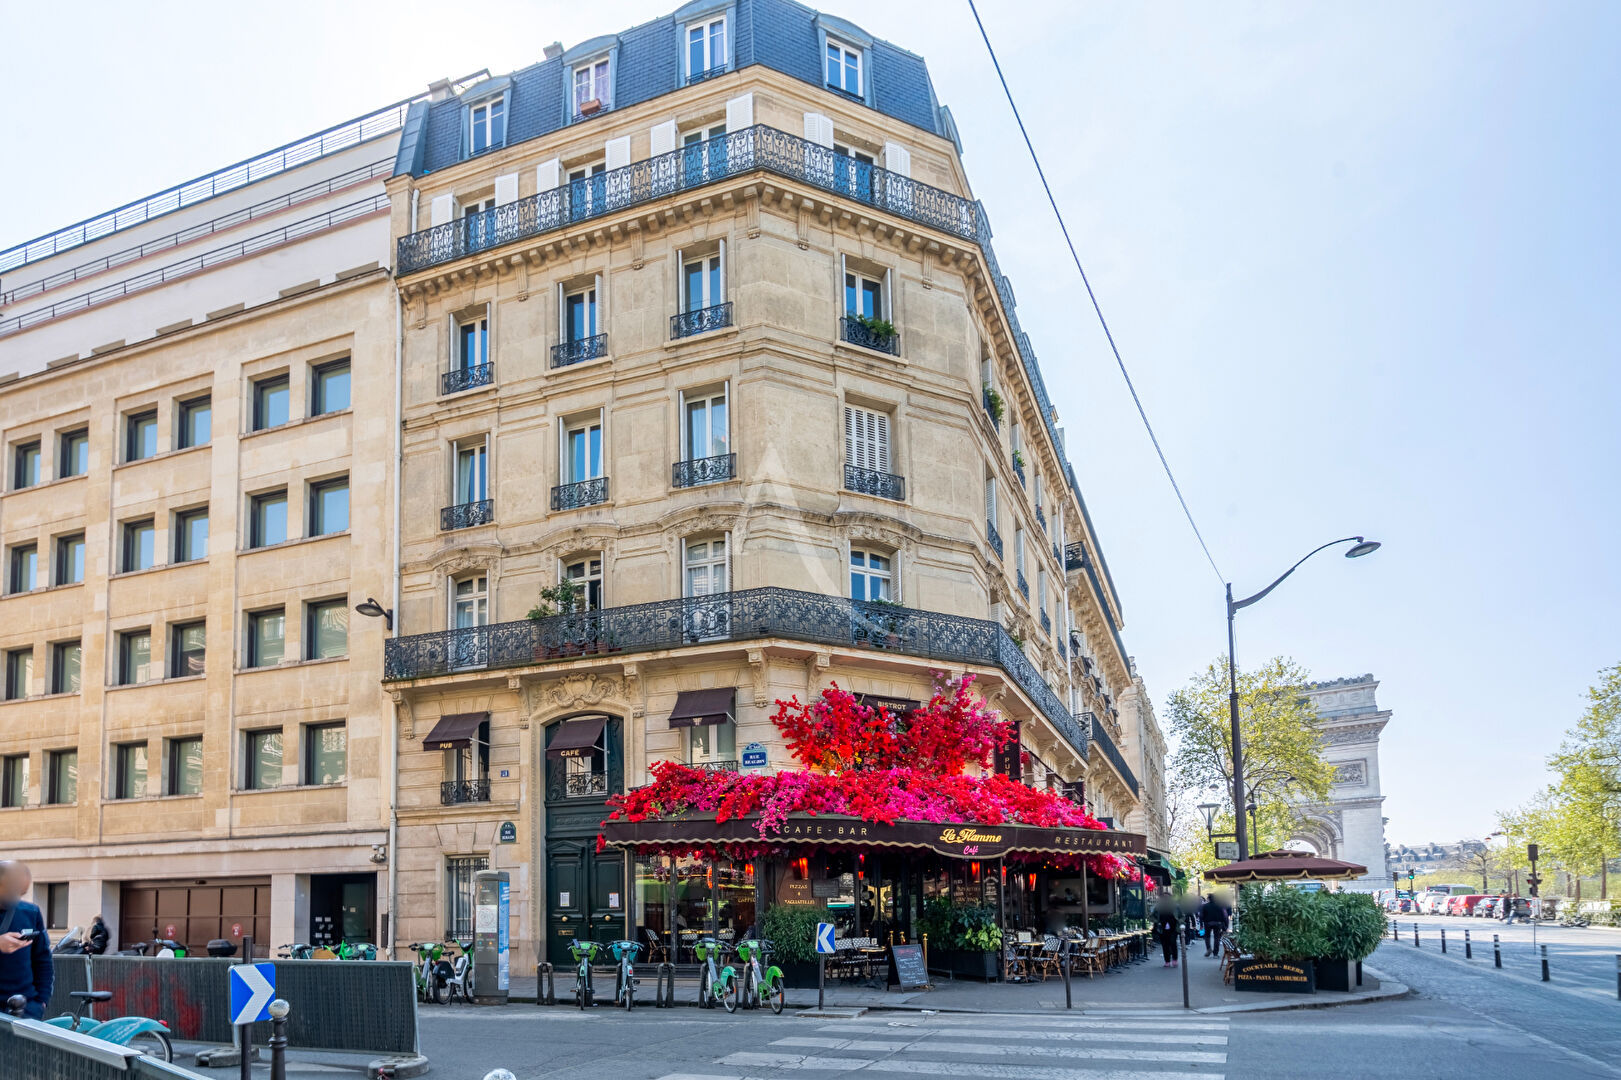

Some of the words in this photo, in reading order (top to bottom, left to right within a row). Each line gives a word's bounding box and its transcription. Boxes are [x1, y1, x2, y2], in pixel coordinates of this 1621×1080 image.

[877, 701, 907, 710] BISTROT
[939, 828, 960, 844] La
[957, 828, 1002, 843] Flamme
[1054, 836, 1134, 848] RESTAURANT
[963, 845, 979, 856] Café
[1242, 963, 1278, 973] COCKTAILS
[1283, 964, 1304, 974] BEERS
